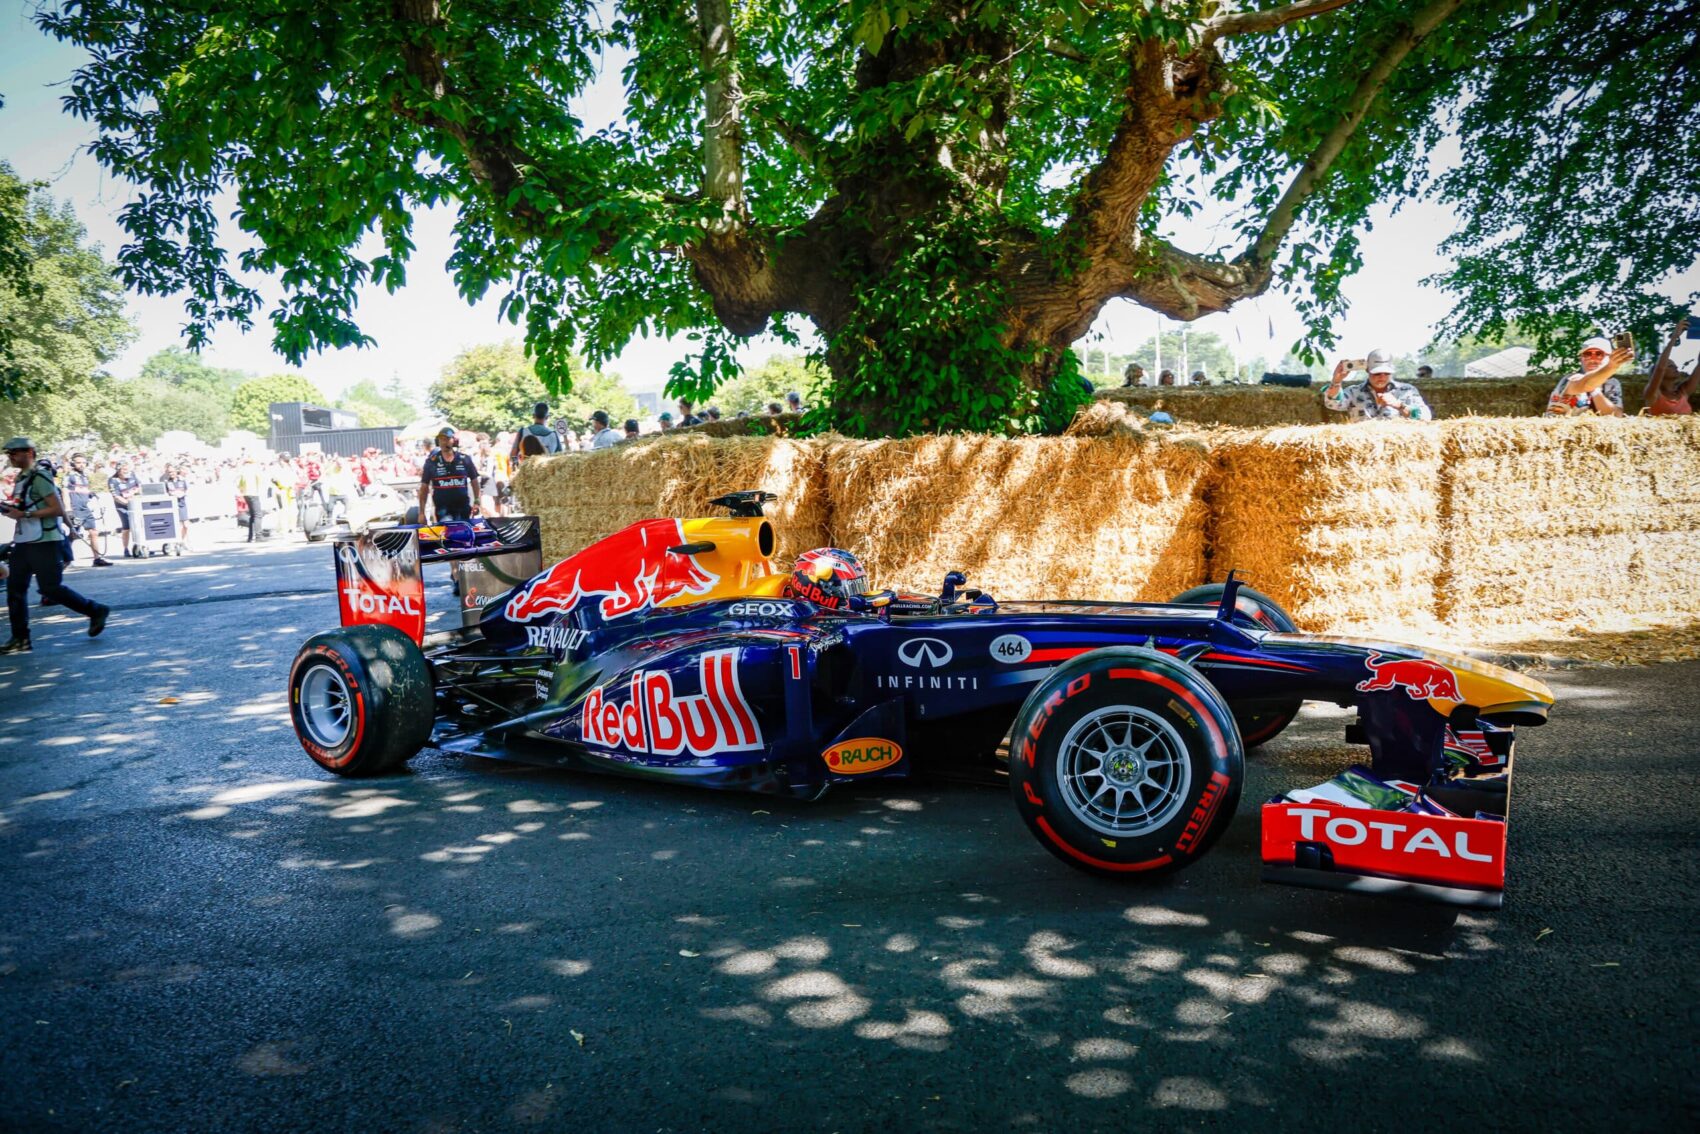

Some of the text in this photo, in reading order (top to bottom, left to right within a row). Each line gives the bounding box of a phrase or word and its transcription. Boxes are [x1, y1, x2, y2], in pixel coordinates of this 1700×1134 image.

[343, 588, 420, 616] TOTAL
[791, 574, 839, 609] Red Bull
[728, 603, 794, 617] GEOX
[524, 625, 591, 651] RENAULT
[997, 641, 1024, 656] 464
[315, 645, 359, 689] ZERO
[788, 647, 801, 680] 1
[877, 675, 978, 690] INFINITI
[582, 647, 764, 757] Red Bull
[1022, 672, 1092, 769] ZERO
[841, 746, 893, 765] RAUCH
[1175, 771, 1231, 854] PIRELLI
[1286, 808, 1493, 863] TOTAL
